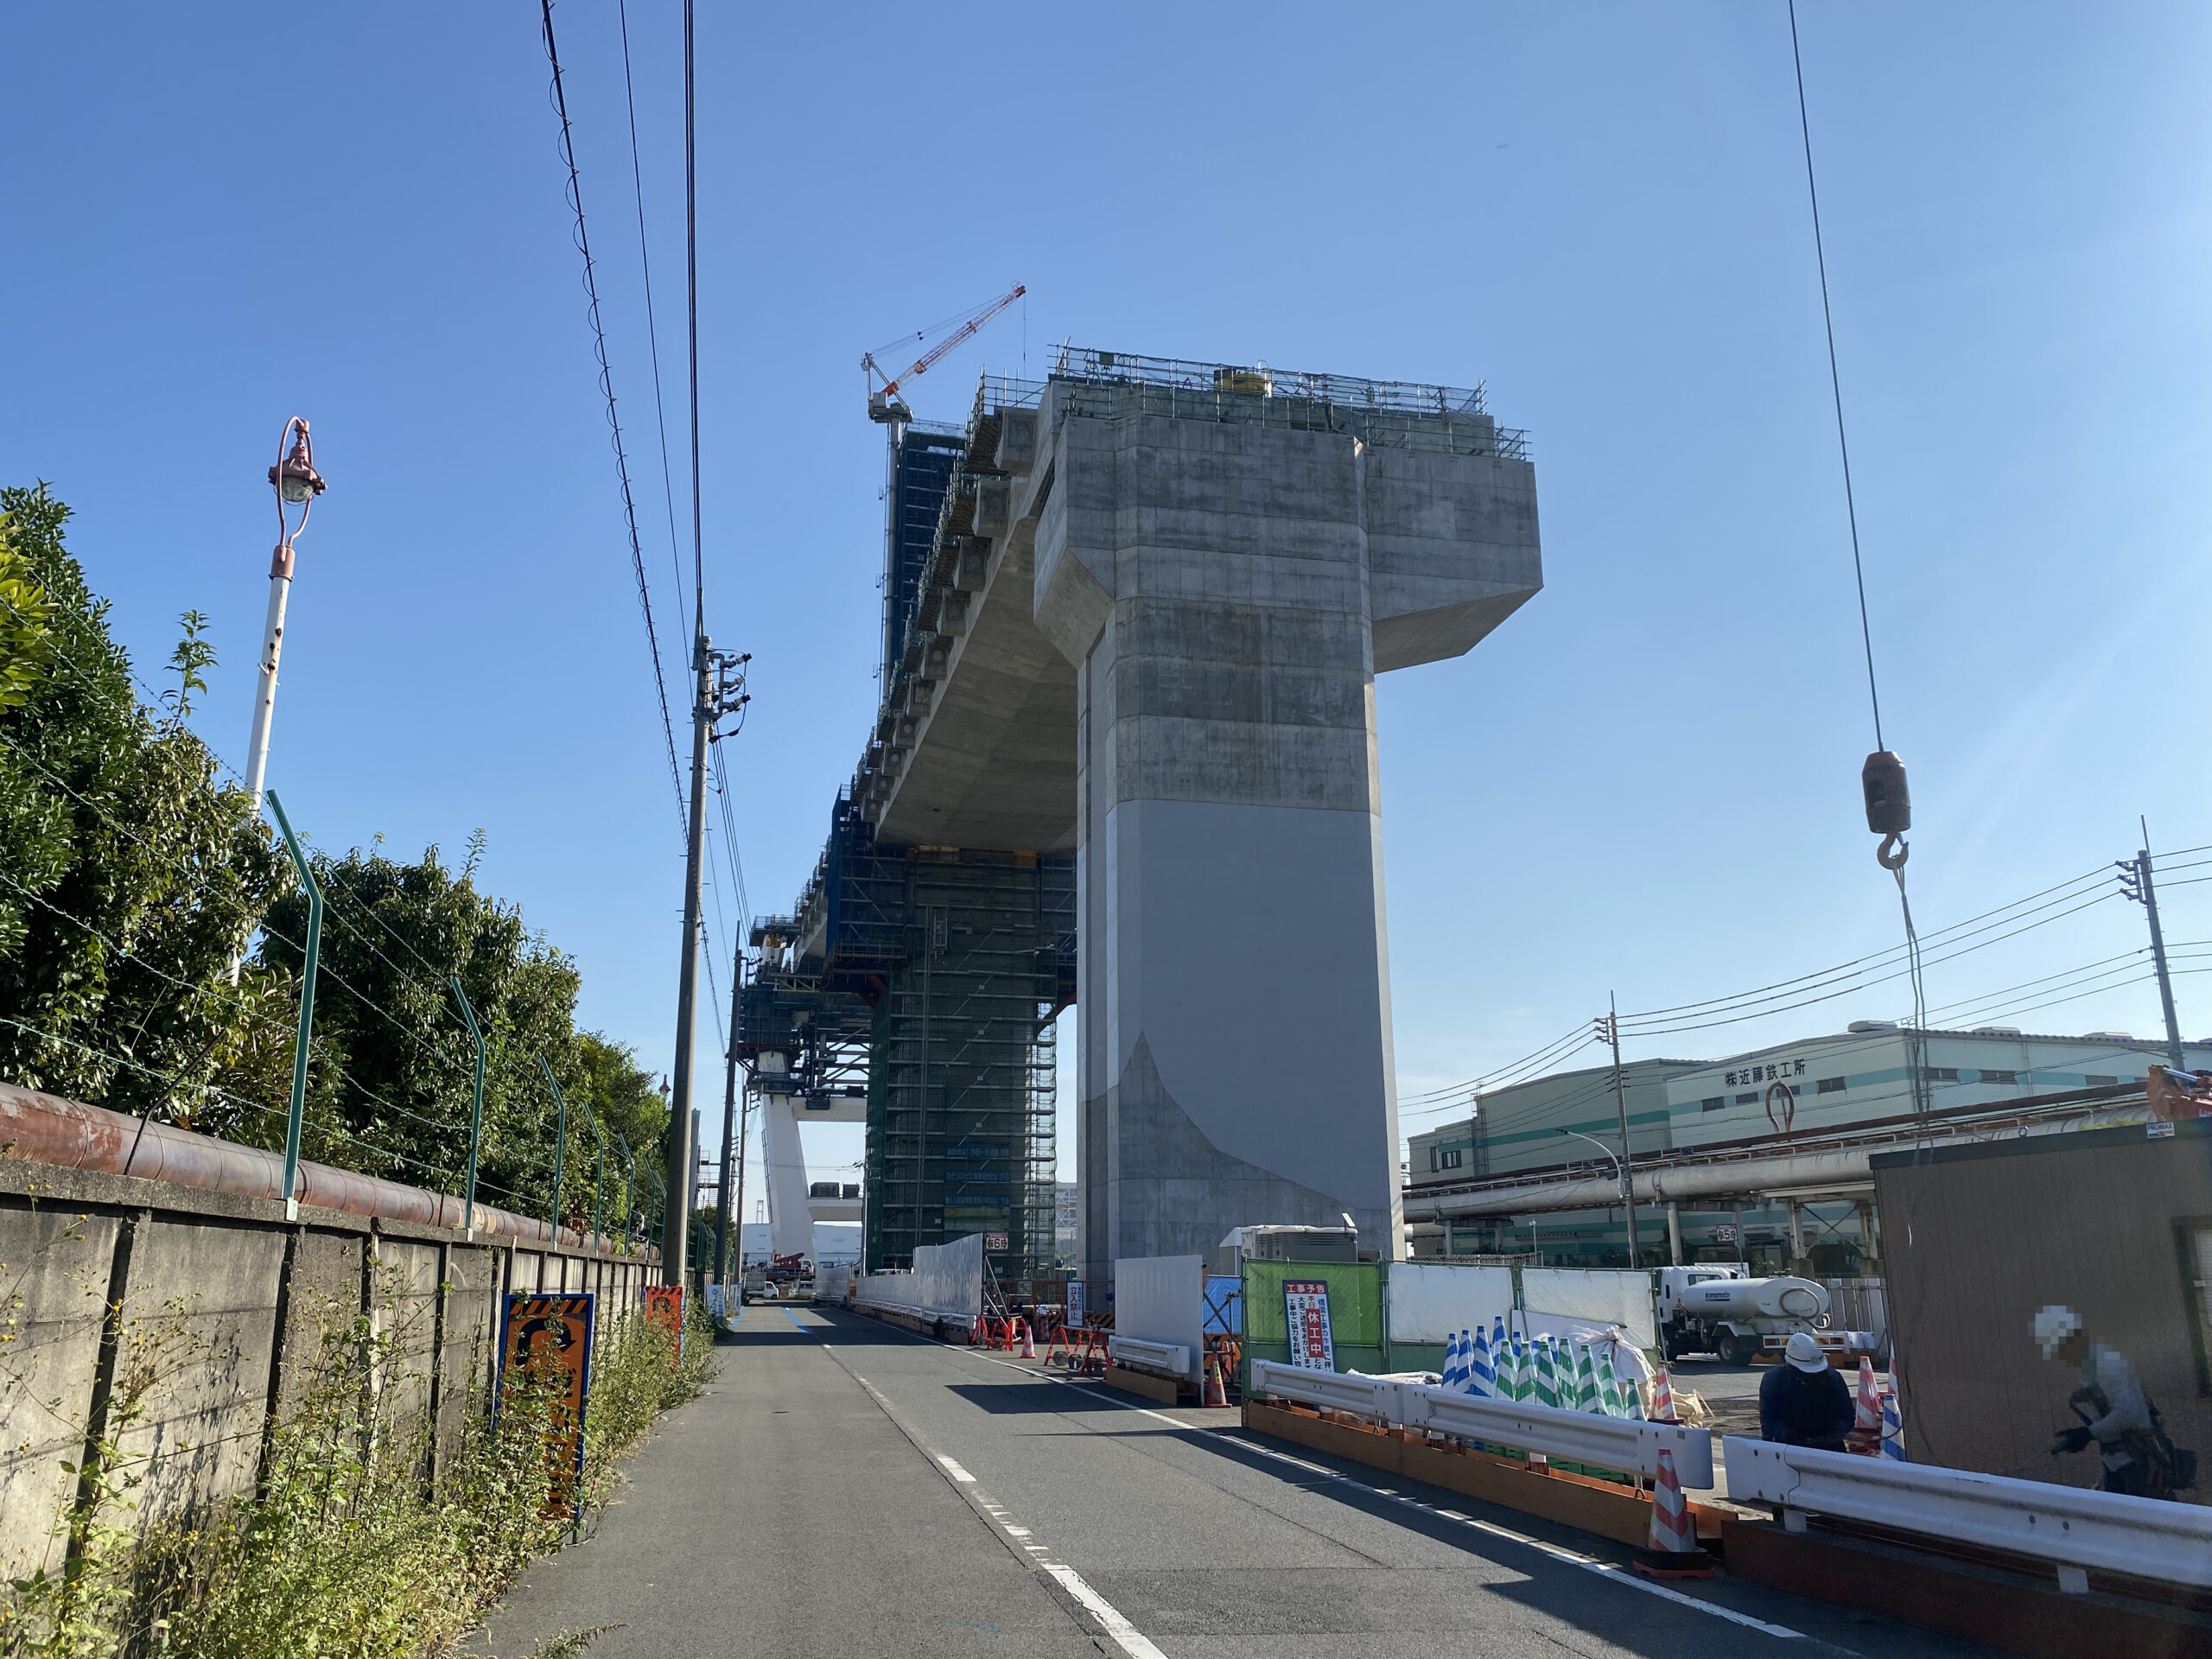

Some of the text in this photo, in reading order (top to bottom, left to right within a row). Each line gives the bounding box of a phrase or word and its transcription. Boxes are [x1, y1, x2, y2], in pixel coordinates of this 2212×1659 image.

[1724, 1230, 1731, 1240] 5
[994, 1238, 1001, 1249] 6
[1287, 1284, 1325, 1294] 工事予告
[1070, 1287, 1078, 1319] 立入禁止
[1307, 1312, 1322, 1355] 休工中
